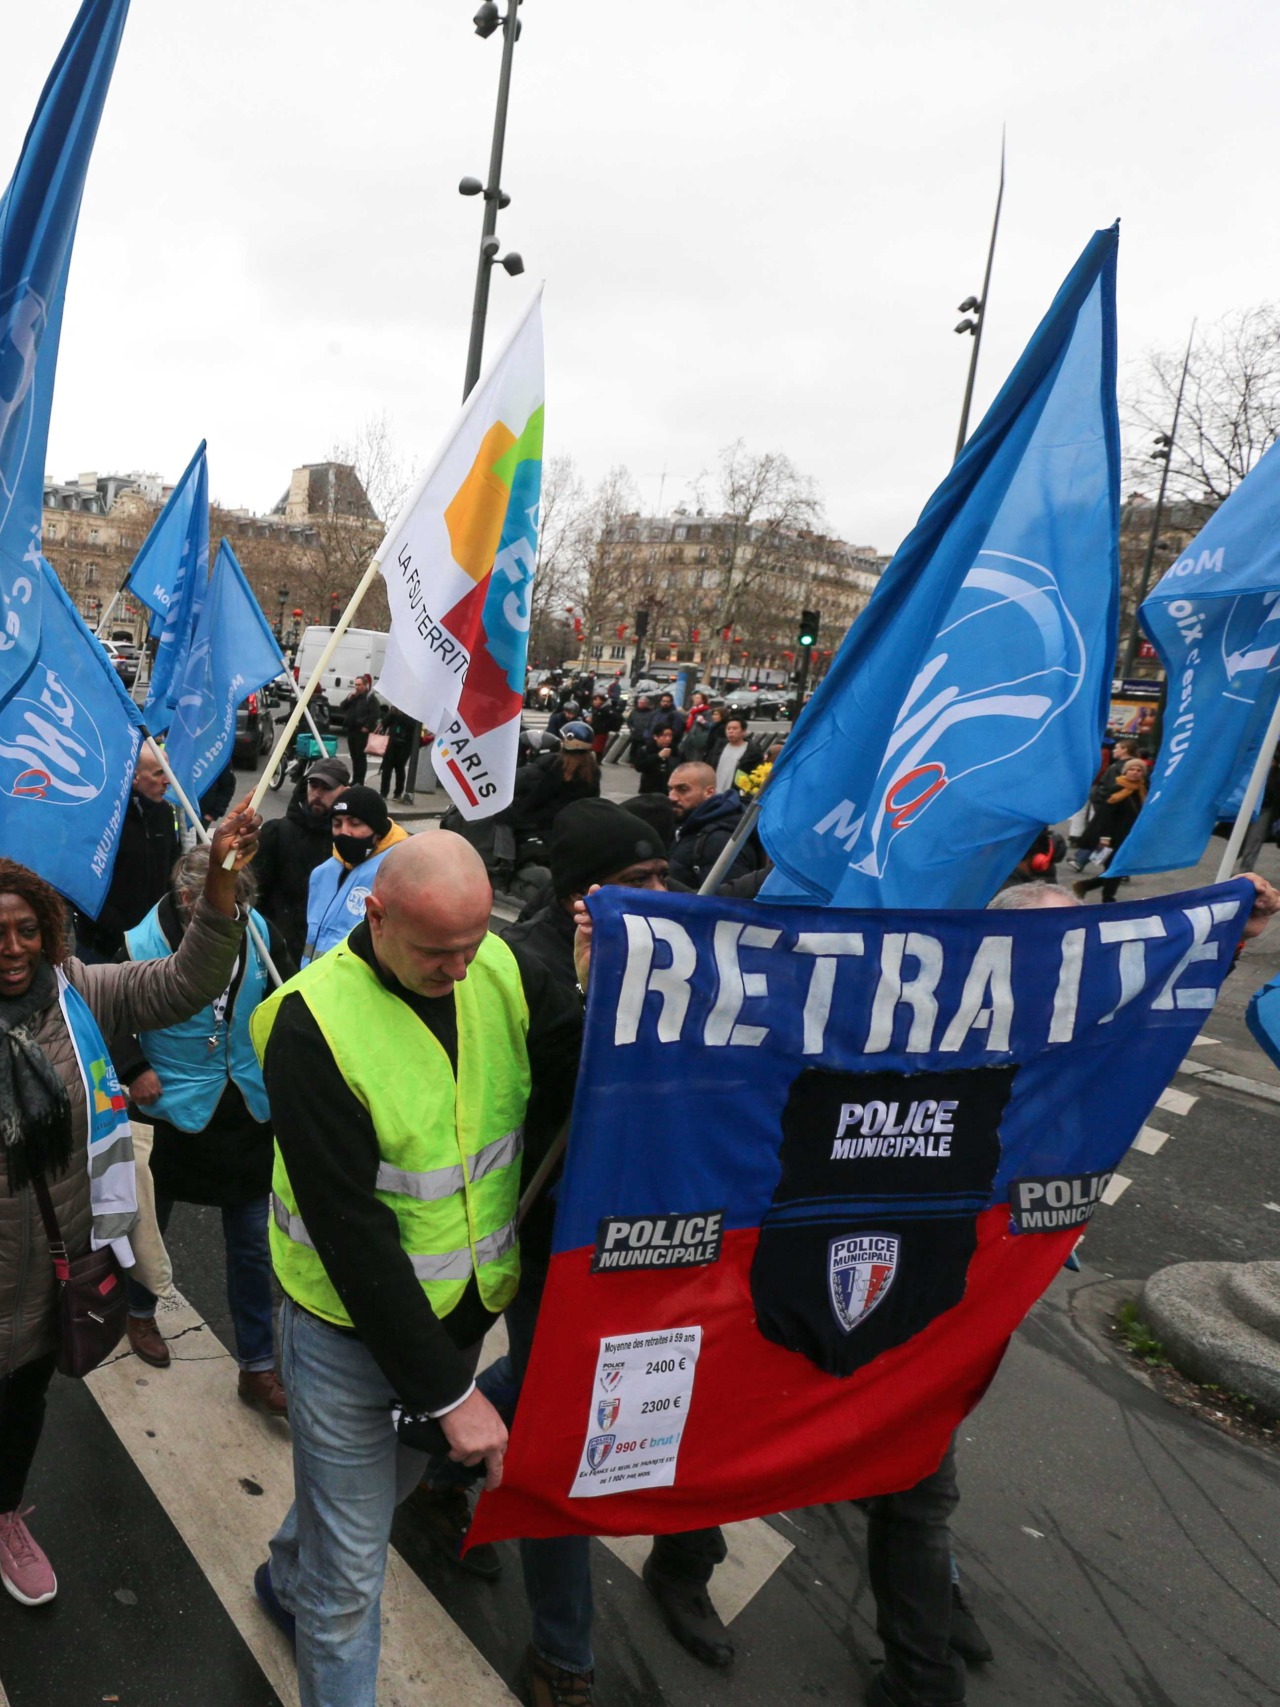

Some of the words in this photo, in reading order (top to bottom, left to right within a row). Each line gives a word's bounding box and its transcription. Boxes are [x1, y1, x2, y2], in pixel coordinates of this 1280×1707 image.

[397, 542, 413, 576] LA
[406, 568, 424, 610] FSU
[445, 720, 497, 799] PARIS
[615, 900, 1241, 1054] RETRAITE
[836, 1100, 959, 1138] POLICE
[830, 1136, 952, 1160] MUNICIPALE
[1019, 1173, 1112, 1208] POLIC
[604, 1214, 722, 1249] POLICE
[599, 1243, 716, 1267] MUNICIPALE
[833, 1252, 895, 1267] MUNICIPALE
[834, 1238, 895, 1258] POLICE
[604, 1339, 632, 1354] Moyenne
[633, 1338, 644, 1349] des
[644, 1335, 669, 1348] retraites
[674, 1333, 683, 1343] 59
[684, 1333, 695, 1342] ans
[646, 1360, 675, 1375] 2400
[678, 1357, 686, 1370] €
[641, 1398, 670, 1414] 2300
[673, 1396, 681, 1408] €
[615, 1441, 637, 1453] 990
[639, 1438, 648, 1449] €
[649, 1434, 674, 1448] brut
